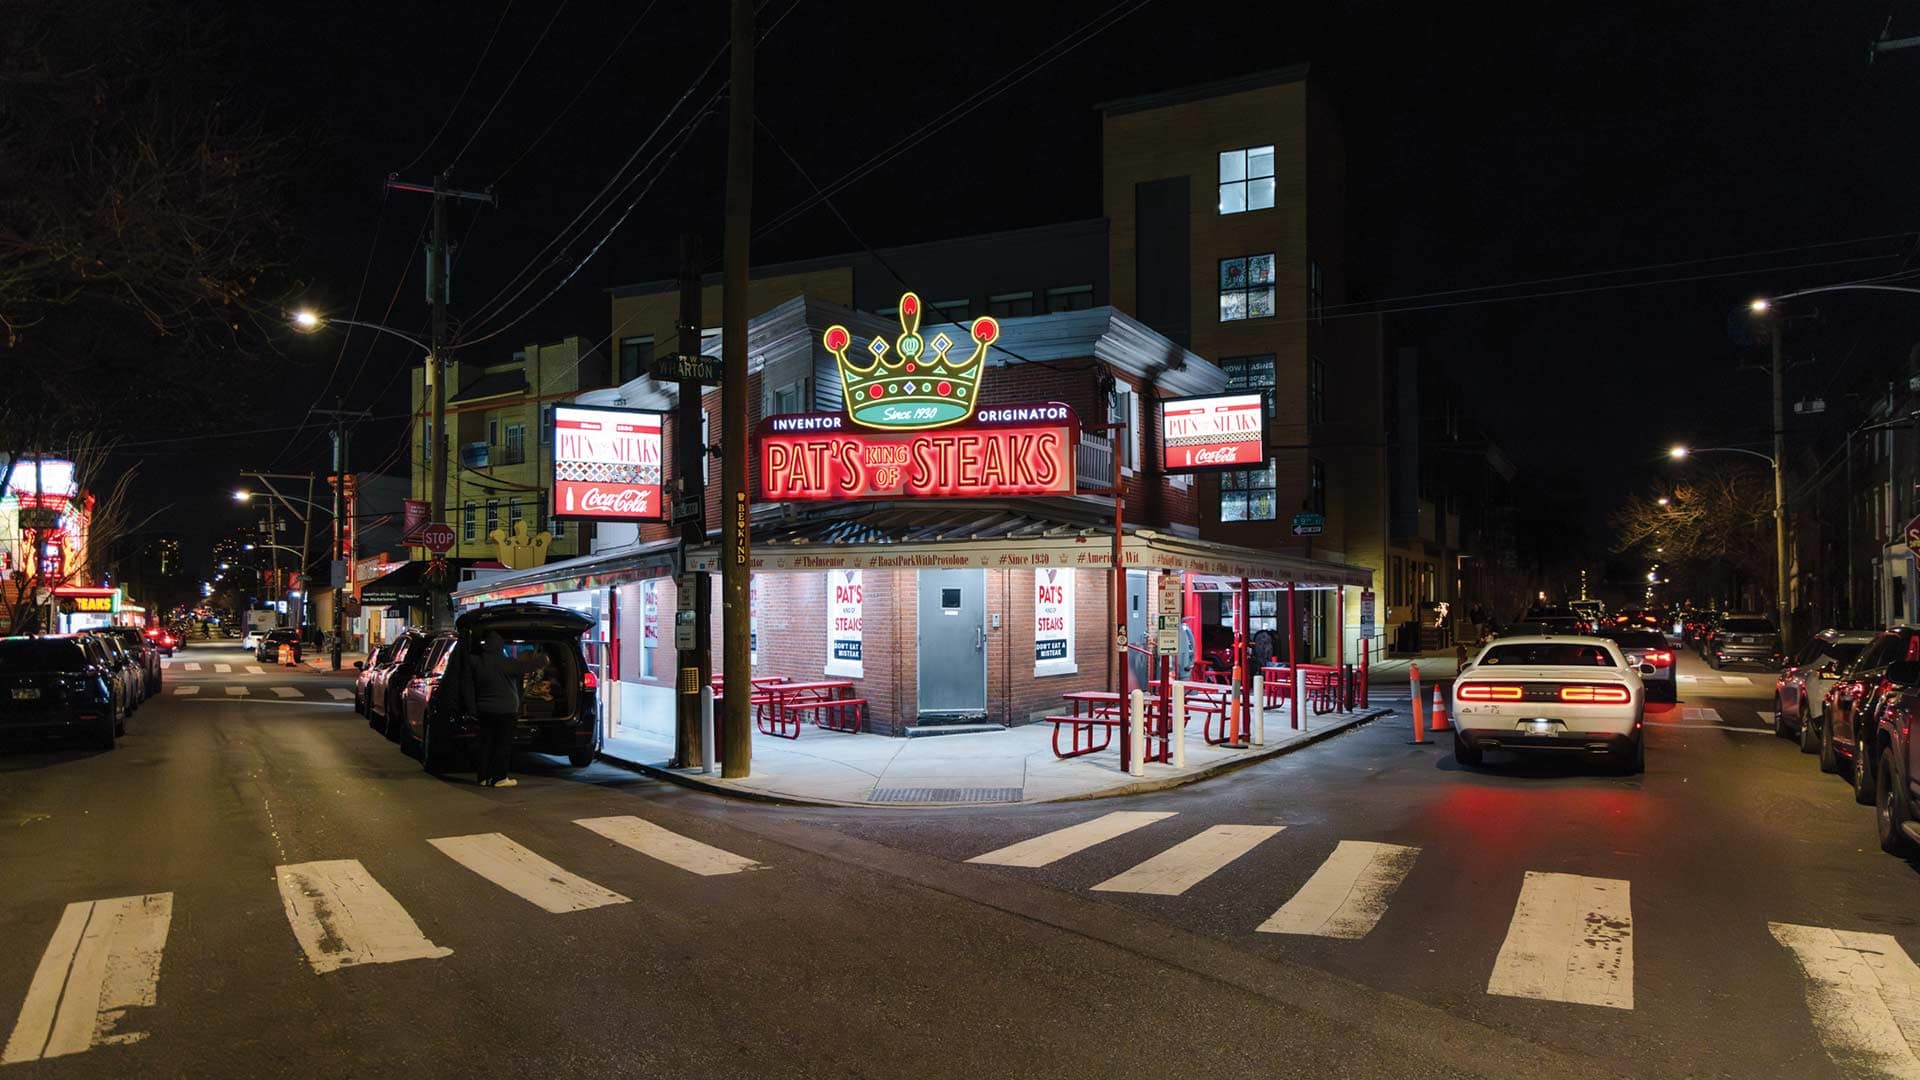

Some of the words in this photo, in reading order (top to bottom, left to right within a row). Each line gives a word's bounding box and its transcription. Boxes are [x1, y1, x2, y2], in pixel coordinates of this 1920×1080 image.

[883, 408, 912, 422] Since
[914, 407, 938, 422] 1930
[977, 407, 1068, 423] ORIGINATOR
[773, 417, 842, 432] INVENTOR
[864, 445, 908, 465] KING
[910, 433, 1059, 488] STEAKS
[1195, 446, 1238, 464] Coca-Cola
[766, 440, 860, 492] PAT'S
[875, 468, 899, 486] OF
[581, 488, 651, 512] Coca-Cola
[426, 533, 453, 544] STOP
[999, 554, 1028, 565] #Since
[1032, 553, 1049, 565] 1930
[837, 585, 863, 604] PAT'S
[1039, 585, 1063, 604] PAT'S
[75, 598, 111, 611] TEAKS
[835, 617, 863, 631] STEAKS
[1038, 618, 1063, 631] STEAKS
